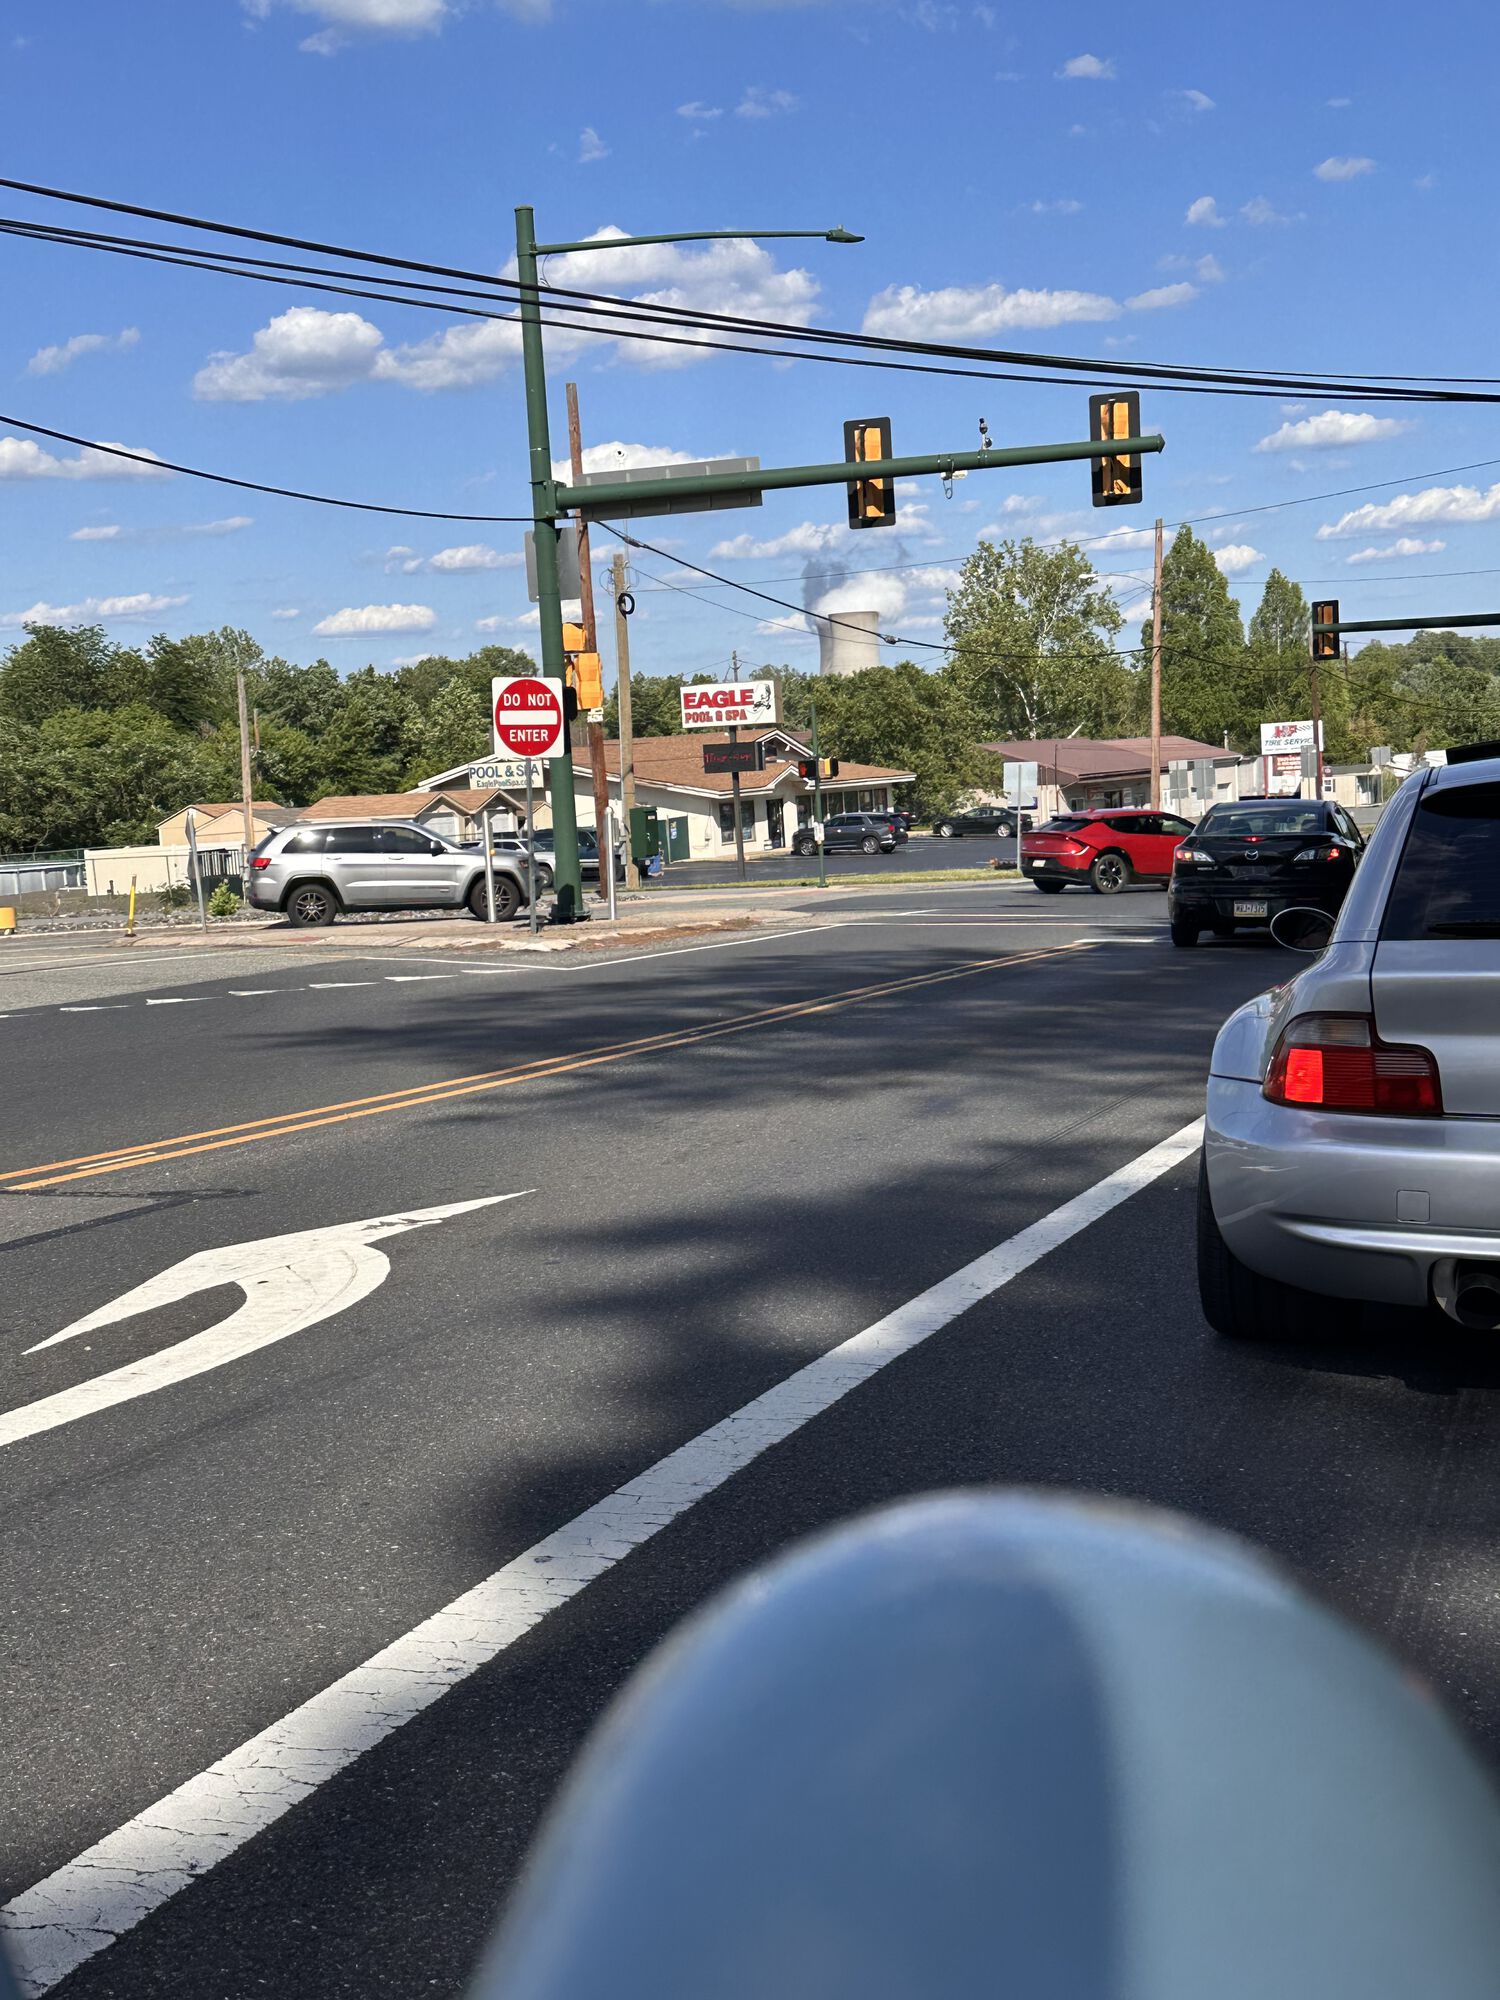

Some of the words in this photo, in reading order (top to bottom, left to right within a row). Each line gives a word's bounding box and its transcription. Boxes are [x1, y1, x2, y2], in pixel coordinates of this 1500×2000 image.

[503, 693, 520, 707] DO
[528, 693, 552, 706] NOT
[683, 689, 754, 710] EAGLE
[685, 710, 713, 724] POOL
[725, 709, 747, 721] SPA
[509, 729, 549, 742] ENTER
[1284, 737, 1314, 746] SERVIC
[469, 766, 503, 780] POOL
[505, 765, 515, 778] &
